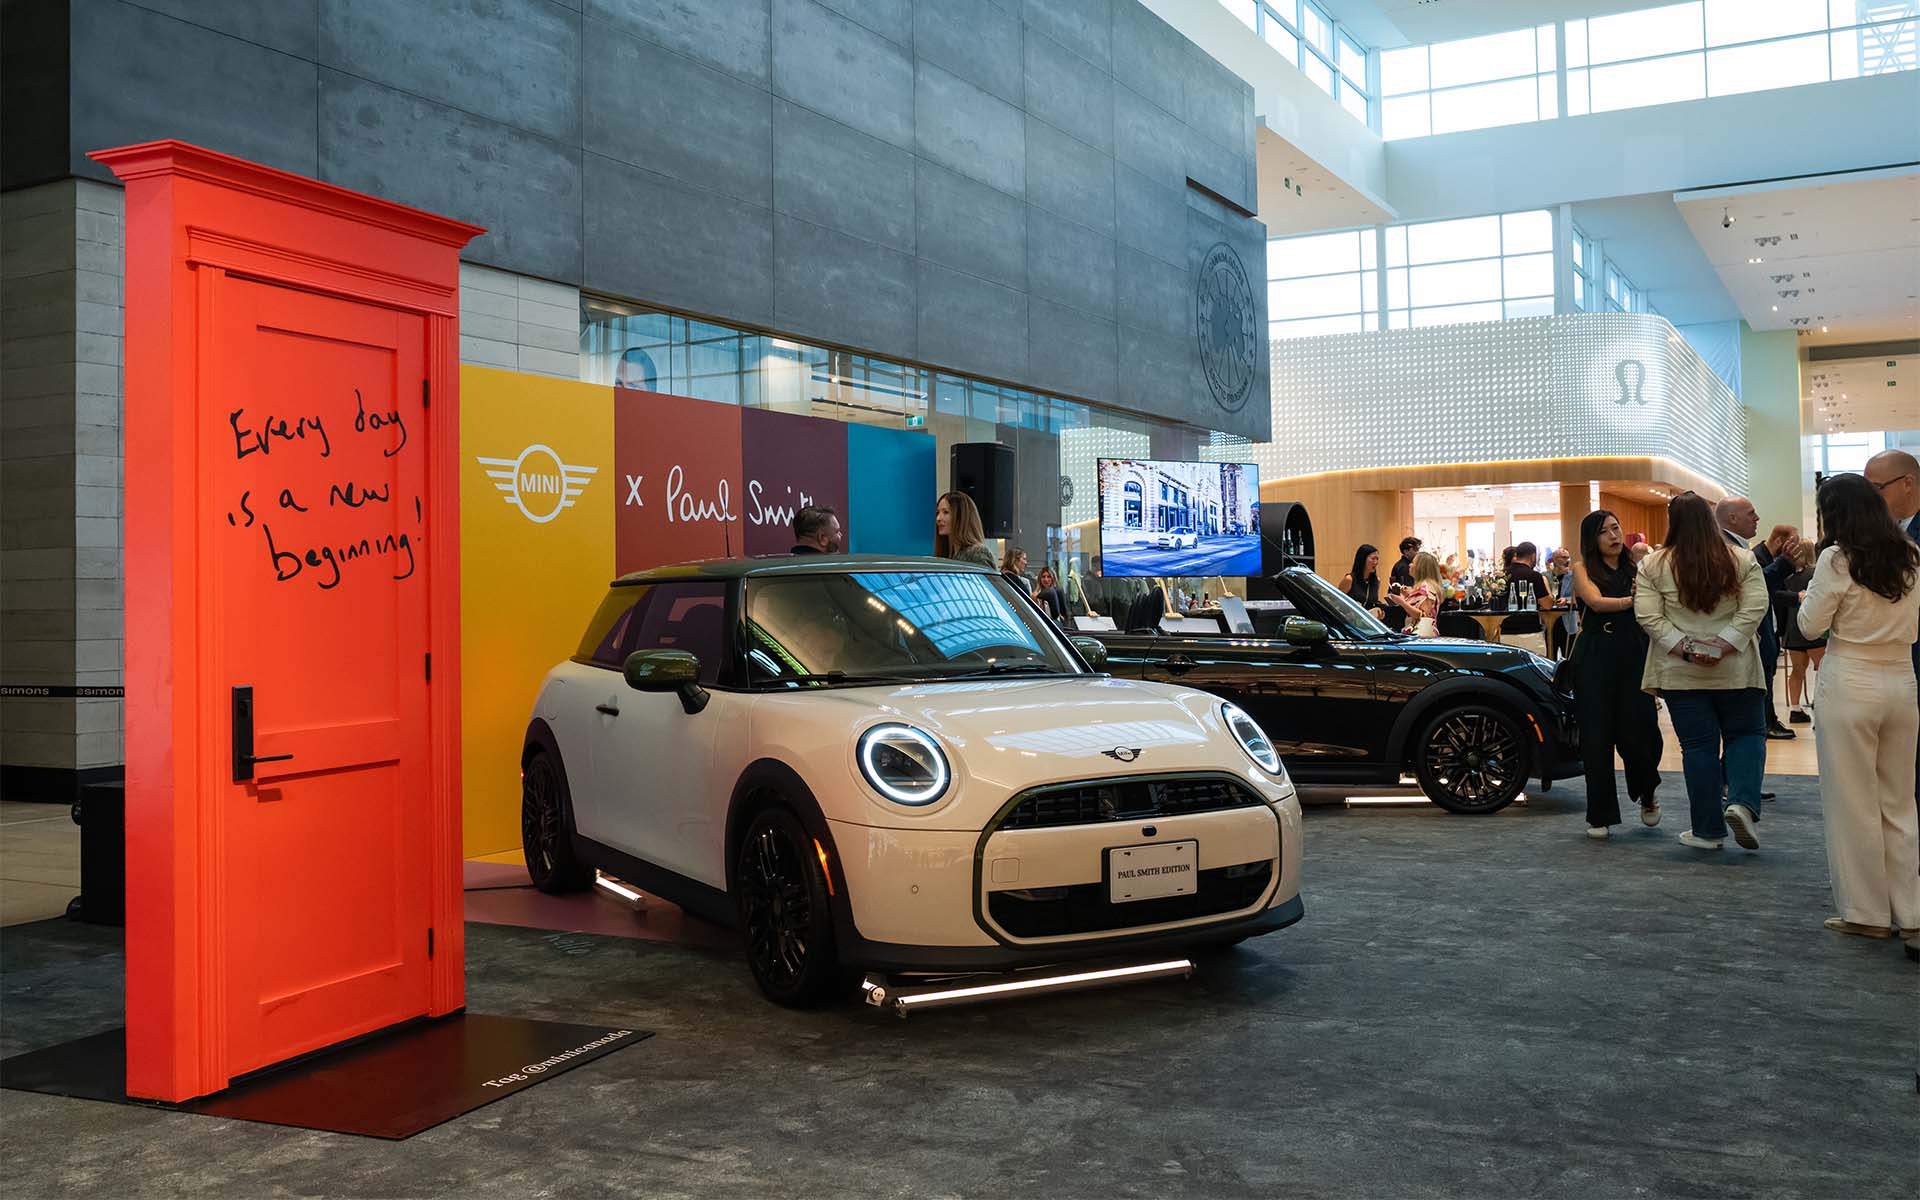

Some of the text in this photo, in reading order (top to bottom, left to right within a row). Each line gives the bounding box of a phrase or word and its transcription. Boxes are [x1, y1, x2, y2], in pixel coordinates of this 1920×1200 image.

[230, 388, 407, 459] Every day
[227, 482, 389, 527] is a new
[521, 473, 560, 495] MINI
[666, 464, 738, 523] Paul
[262, 495, 422, 589] beginning!
[0, 687, 124, 696] simons simon
[1117, 863, 1191, 880] PAUL SMITH EDITION
[481, 1028, 633, 1089] Tag @minicanada
